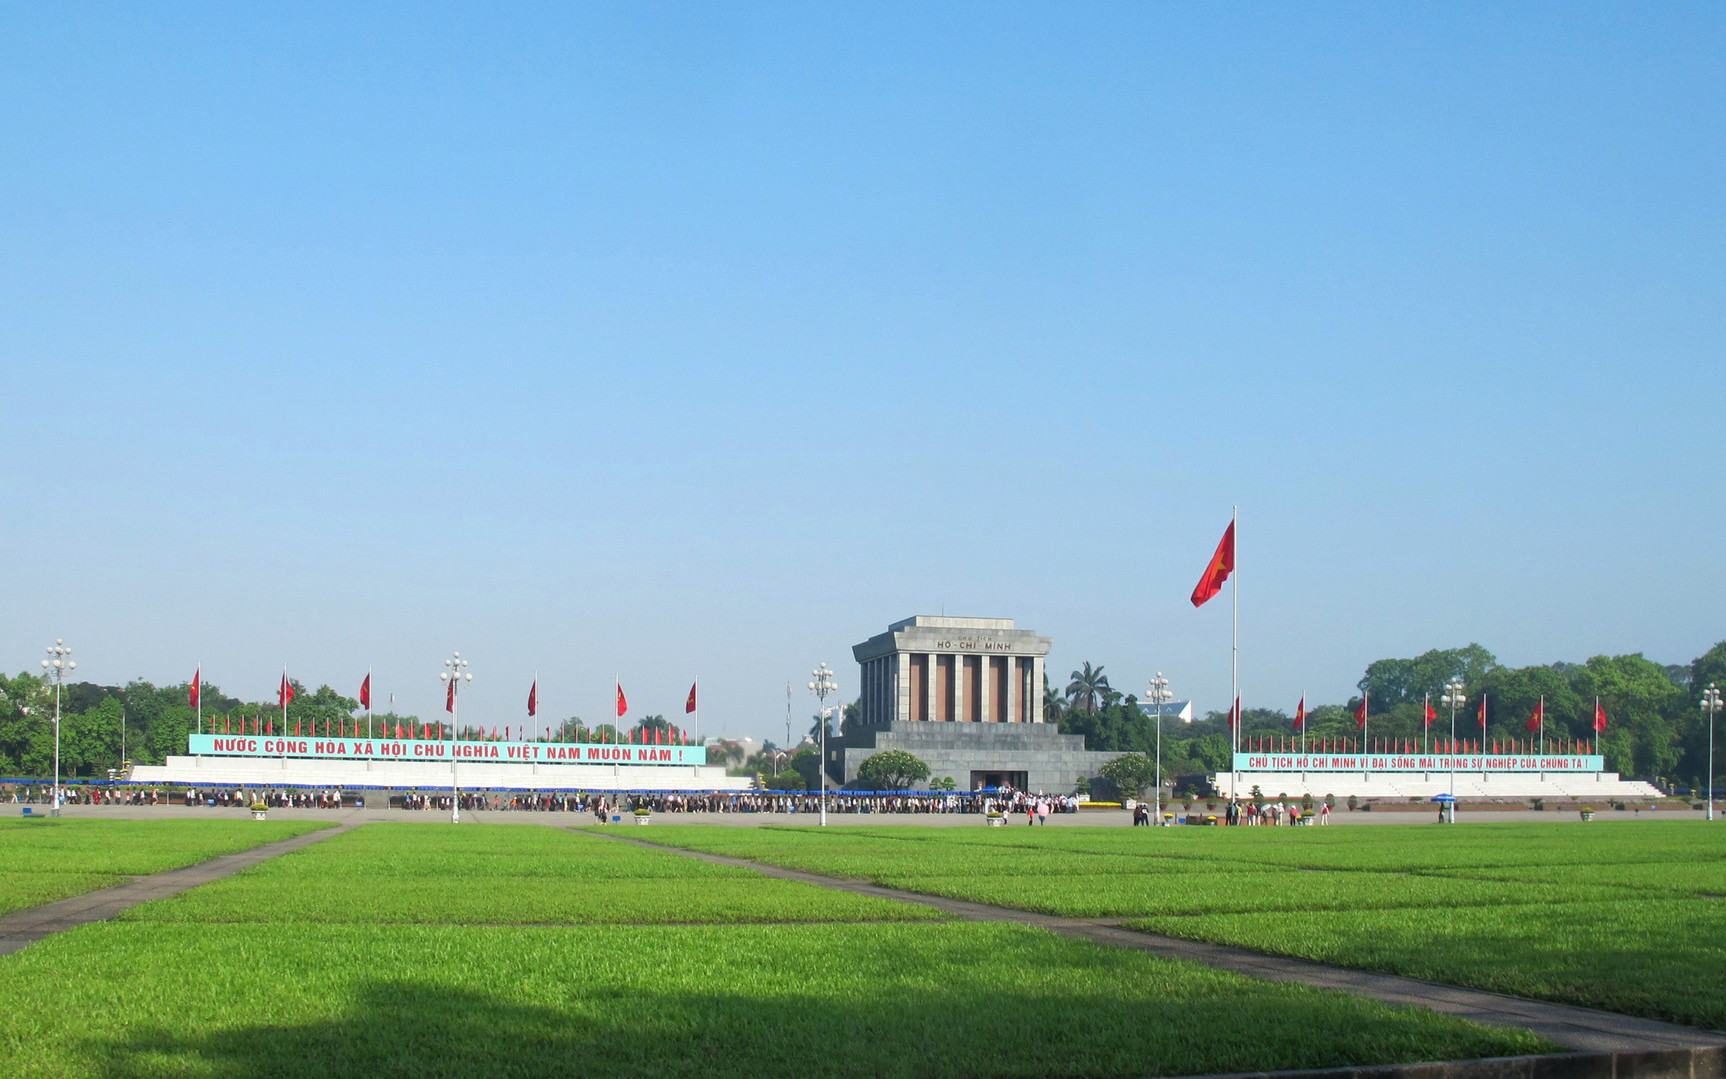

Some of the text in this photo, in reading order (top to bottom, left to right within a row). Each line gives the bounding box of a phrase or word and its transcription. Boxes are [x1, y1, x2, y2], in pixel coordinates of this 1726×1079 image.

[214, 737, 257, 752] NƯỚC
[265, 738, 308, 756] CỘNG
[315, 741, 347, 754] HÒA
[354, 740, 374, 755] XÃ
[381, 741, 407, 757] HỘI
[414, 742, 444, 757] CHỦ
[452, 743, 499, 758] NGHĨA
[507, 744, 540, 760] VIỆT
[547, 747, 580, 760] NAM
[588, 746, 632, 761] MUÔN
[639, 747, 672, 762] NĂM
[1331, 757, 1356, 768] MINH
[1572, 759, 1582, 769] TA
